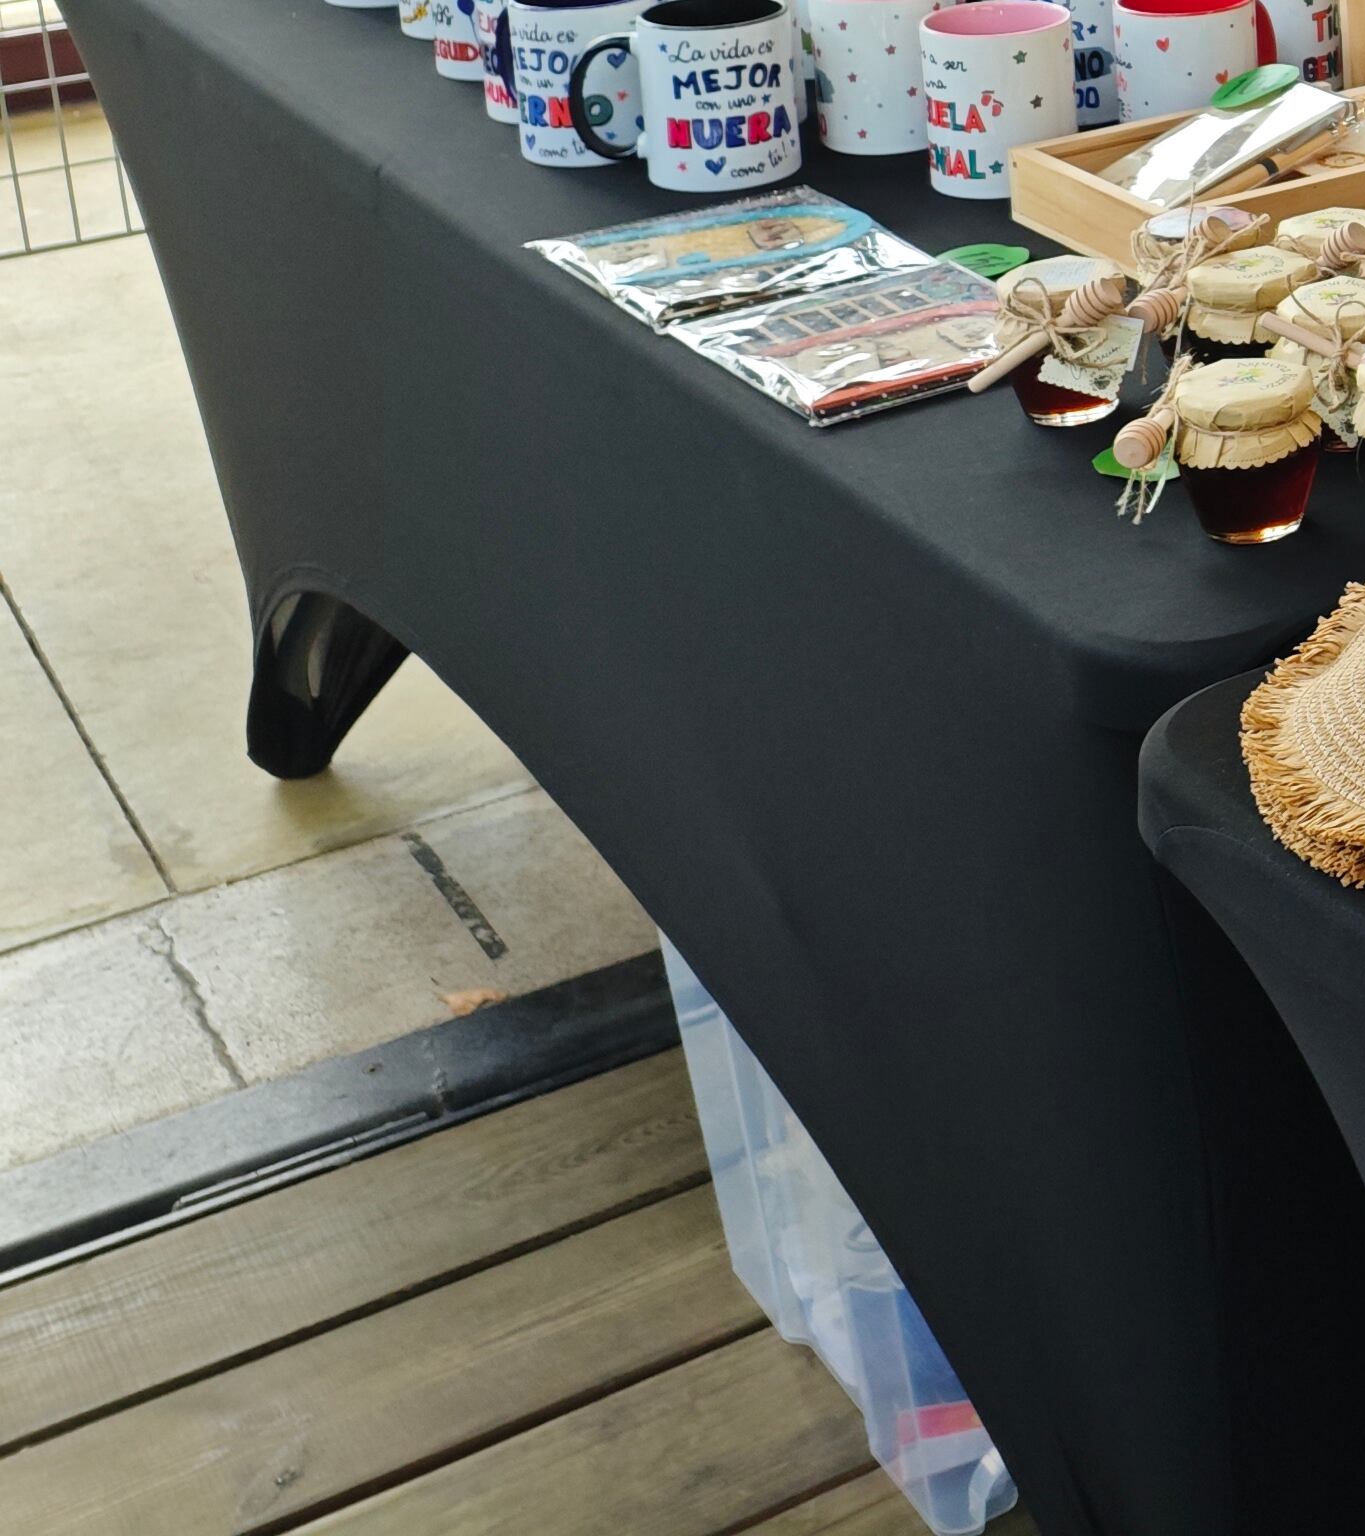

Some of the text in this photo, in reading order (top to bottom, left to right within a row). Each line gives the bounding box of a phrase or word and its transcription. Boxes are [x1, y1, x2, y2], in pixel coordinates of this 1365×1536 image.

[670, 37, 775, 63] La vida es
[673, 63, 782, 100] MEJOR
[695, 95, 757, 111] con una
[667, 105, 792, 150] NUERA
[730, 163, 765, 180] como
